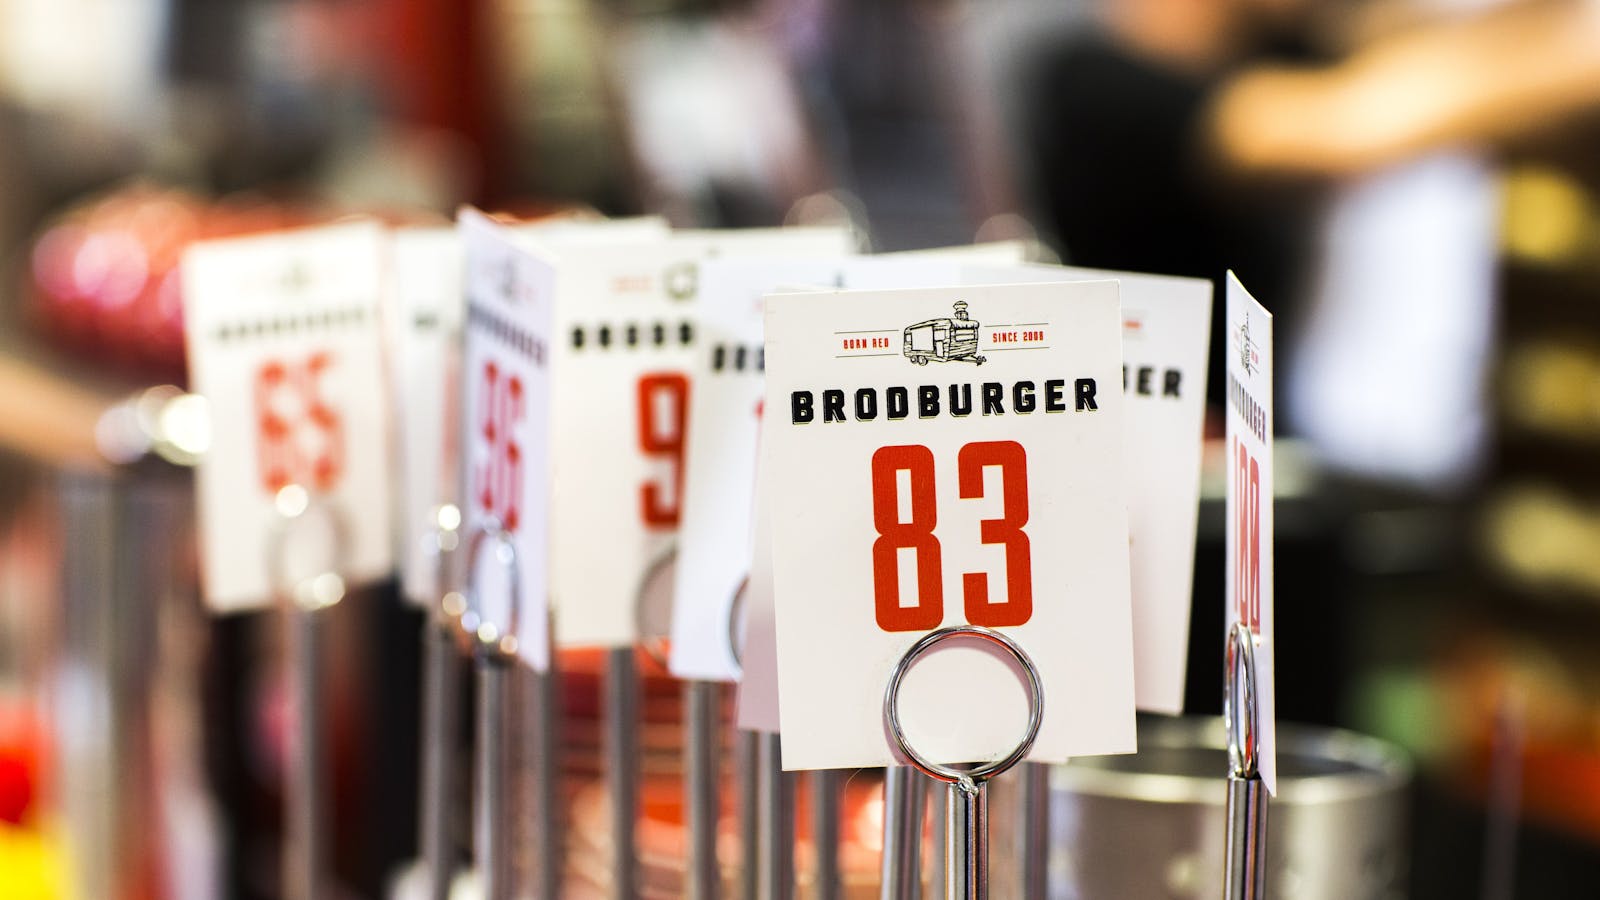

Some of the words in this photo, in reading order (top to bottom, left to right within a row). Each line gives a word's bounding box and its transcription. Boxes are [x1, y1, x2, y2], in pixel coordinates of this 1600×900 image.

[843, 338, 867, 350] BORN
[872, 337, 889, 348] RED
[992, 332, 1018, 343] SINCE
[1023, 331, 1044, 342] 2008
[791, 378, 1098, 425] BRODBURGER
[871, 440, 1033, 632] 83
